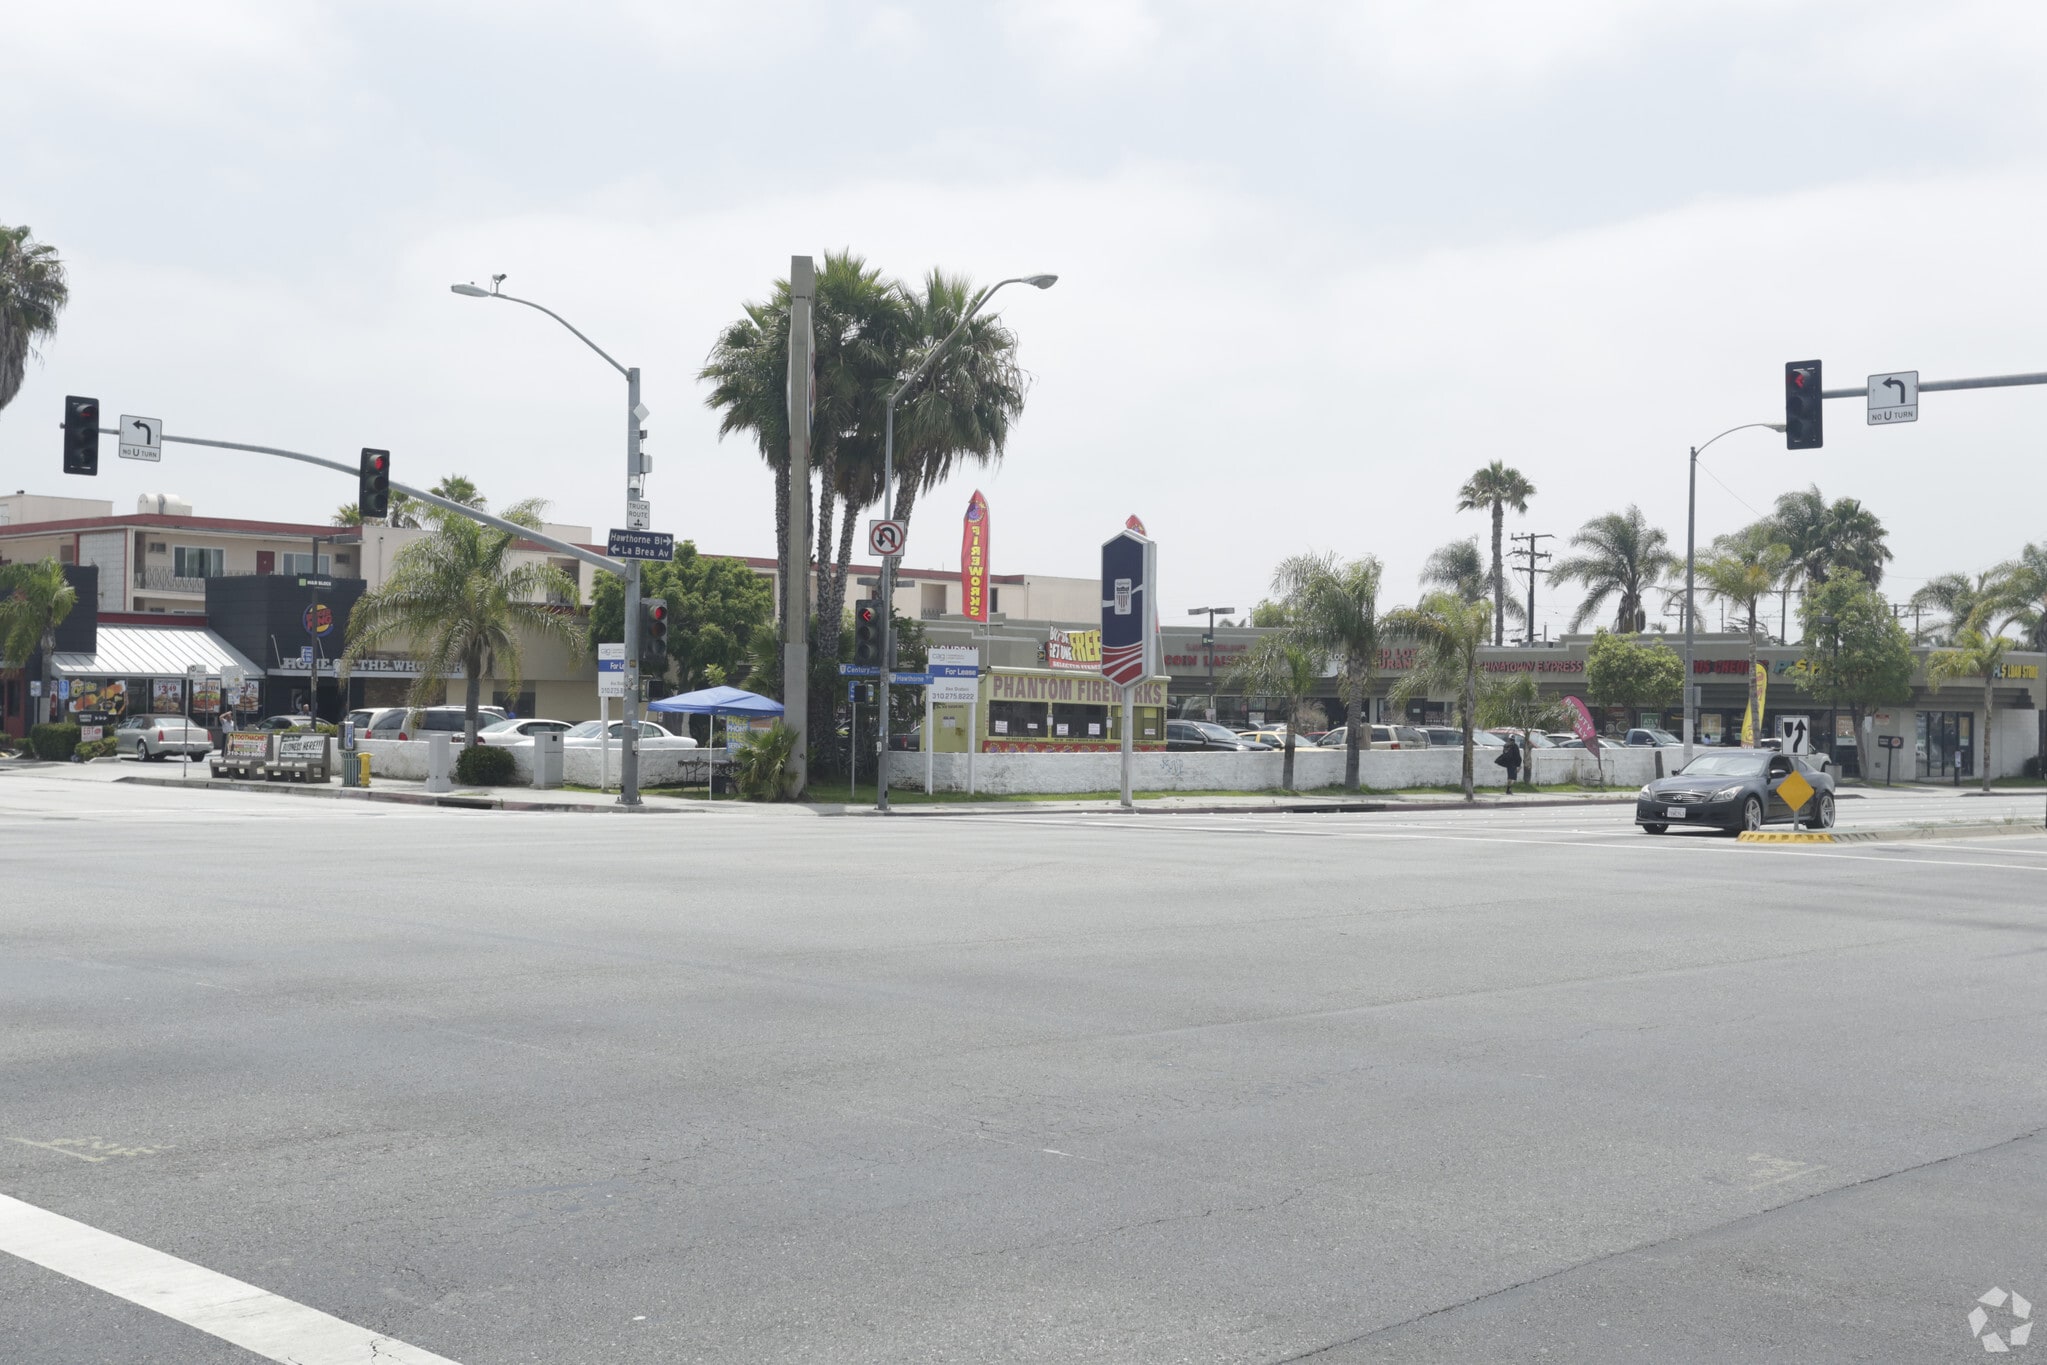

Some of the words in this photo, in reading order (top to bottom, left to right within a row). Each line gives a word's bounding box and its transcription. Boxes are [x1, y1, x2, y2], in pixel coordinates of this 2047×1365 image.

[1872, 413, 1882, 421] NO
[1884, 411, 1892, 421] U
[1894, 411, 1913, 419] TURN
[132, 448, 140, 457] U
[141, 450, 157, 458] TURN
[610, 532, 651, 544] Hawthorne
[654, 536, 663, 545] Bl
[622, 546, 632, 555] La
[635, 547, 655, 557] Brea
[658, 549, 669, 557] Av
[1069, 631, 1101, 662] FREE
[358, 659, 389, 671] THE
[610, 662, 619, 670] For
[1164, 655, 1197, 666] COIN
[846, 666, 870, 675] Century
[945, 667, 956, 675] For
[957, 668, 977, 676] Lease
[1536, 660, 1584, 673] EXPRESS
[993, 676, 1073, 701] PHANTOM
[1077, 680, 1163, 705] FIREWRKS
[727, 732, 746, 742] FRE
